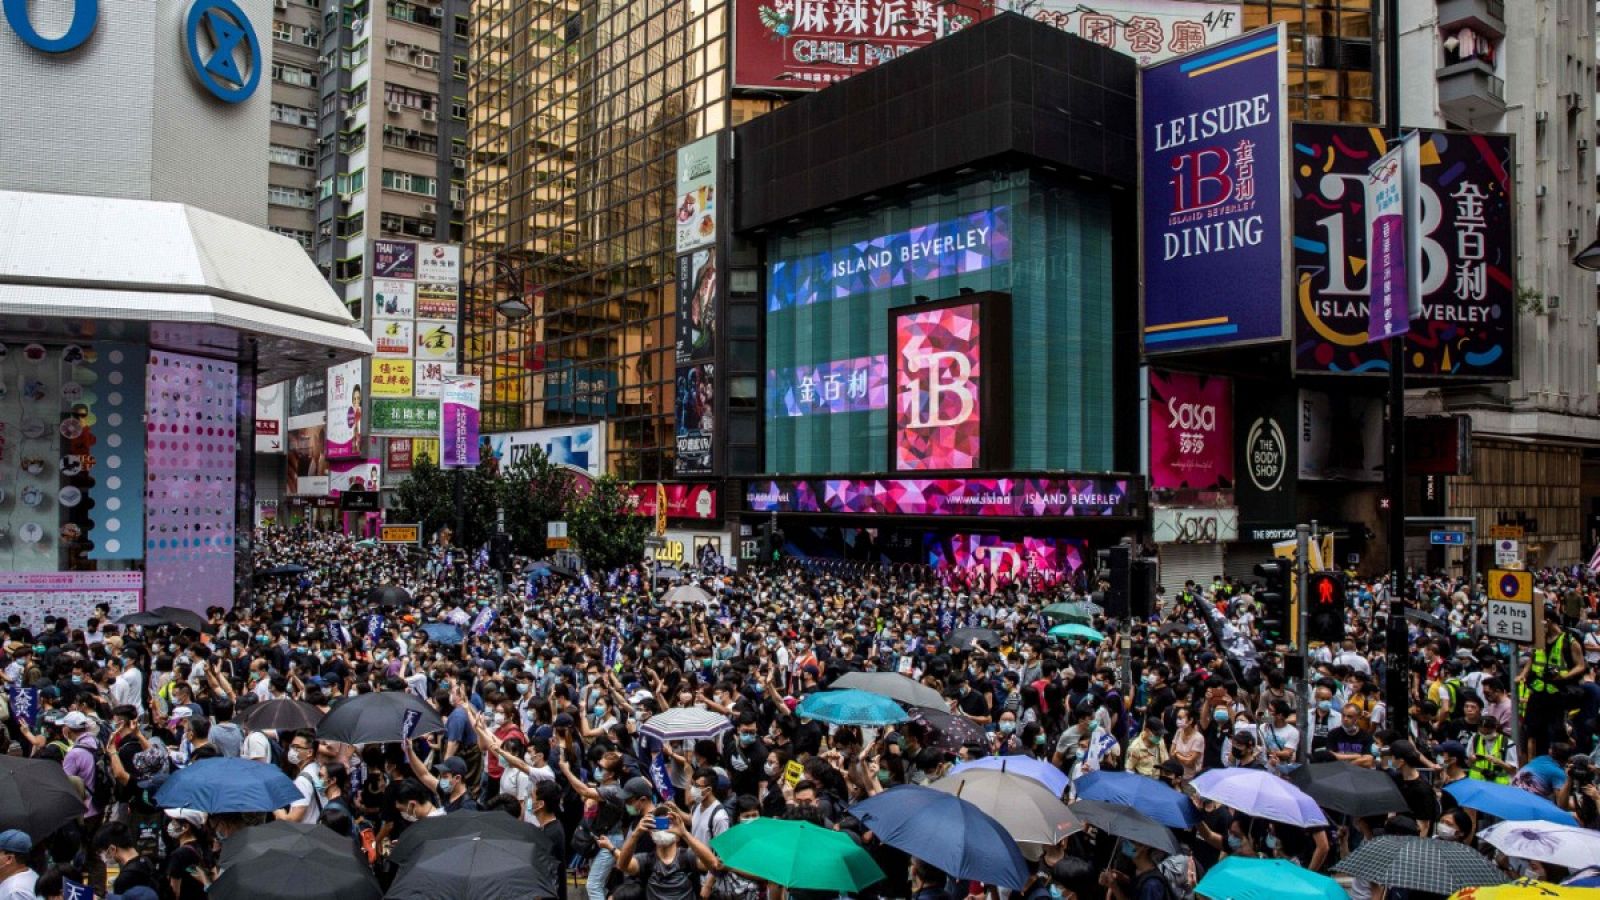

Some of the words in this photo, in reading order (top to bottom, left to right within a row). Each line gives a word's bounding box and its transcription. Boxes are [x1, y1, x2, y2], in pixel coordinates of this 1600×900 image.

[1203, 9, 1236, 32] 4/F
[792, 40, 859, 65] CHILI
[1155, 93, 1271, 152] LEISURE
[1163, 215, 1264, 262] DINING
[1450, 180, 1489, 301] 金百利
[832, 250, 892, 278] ISLAND
[901, 226, 990, 263] BEVERLEY
[1315, 300, 1371, 318] ISLAN
[1418, 304, 1490, 322] VERLEY
[798, 369, 868, 403] 金百利
[906, 351, 974, 429] iB
[1260, 440, 1273, 450] THE
[1254, 451, 1279, 464] BODY
[1255, 465, 1278, 477] SHOP
[1025, 493, 1067, 505] ISLAND
[1071, 493, 1121, 505] BEVERLEY
[1253, 530, 1265, 540] THE
[1265, 530, 1281, 540] BODY
[1281, 529, 1297, 539] SHOP
[1492, 604, 1507, 616] 24
[1509, 604, 1527, 618] hrs
[1496, 619, 1524, 637] 全日
